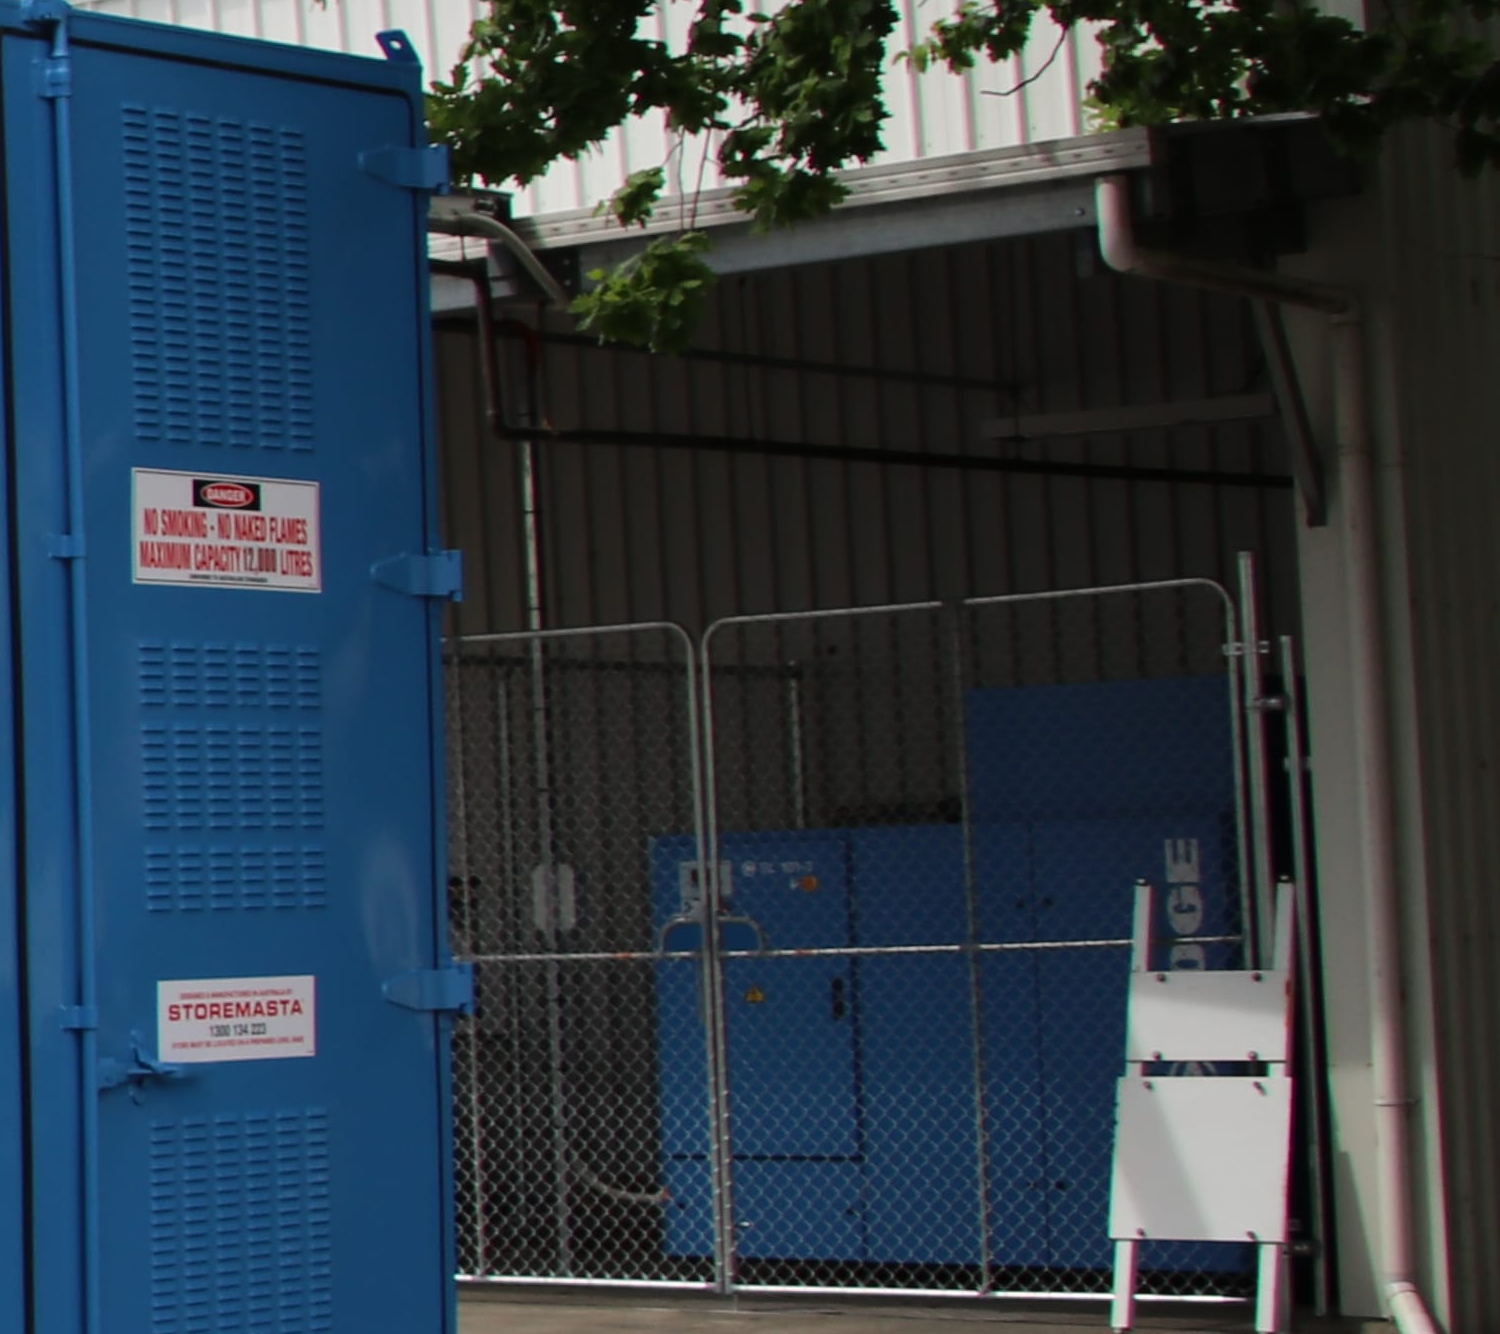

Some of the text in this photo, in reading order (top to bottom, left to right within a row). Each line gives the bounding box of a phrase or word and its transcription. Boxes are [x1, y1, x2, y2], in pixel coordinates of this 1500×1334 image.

[207, 489, 246, 501] DANGER
[144, 508, 158, 535] NO
[162, 509, 207, 537] SMOKING
[218, 513, 231, 539] NO
[234, 514, 266, 542] NAKED
[270, 517, 307, 545] FLAMES
[140, 541, 191, 569] MAXIMUM
[195, 545, 241, 571] CAPACITY
[281, 551, 313, 576] LITRES
[1163, 838, 1207, 972] OGE
[169, 1000, 303, 1021] STOREMASTA
[210, 1025, 230, 1037] 1300
[233, 1024, 248, 1036] 134
